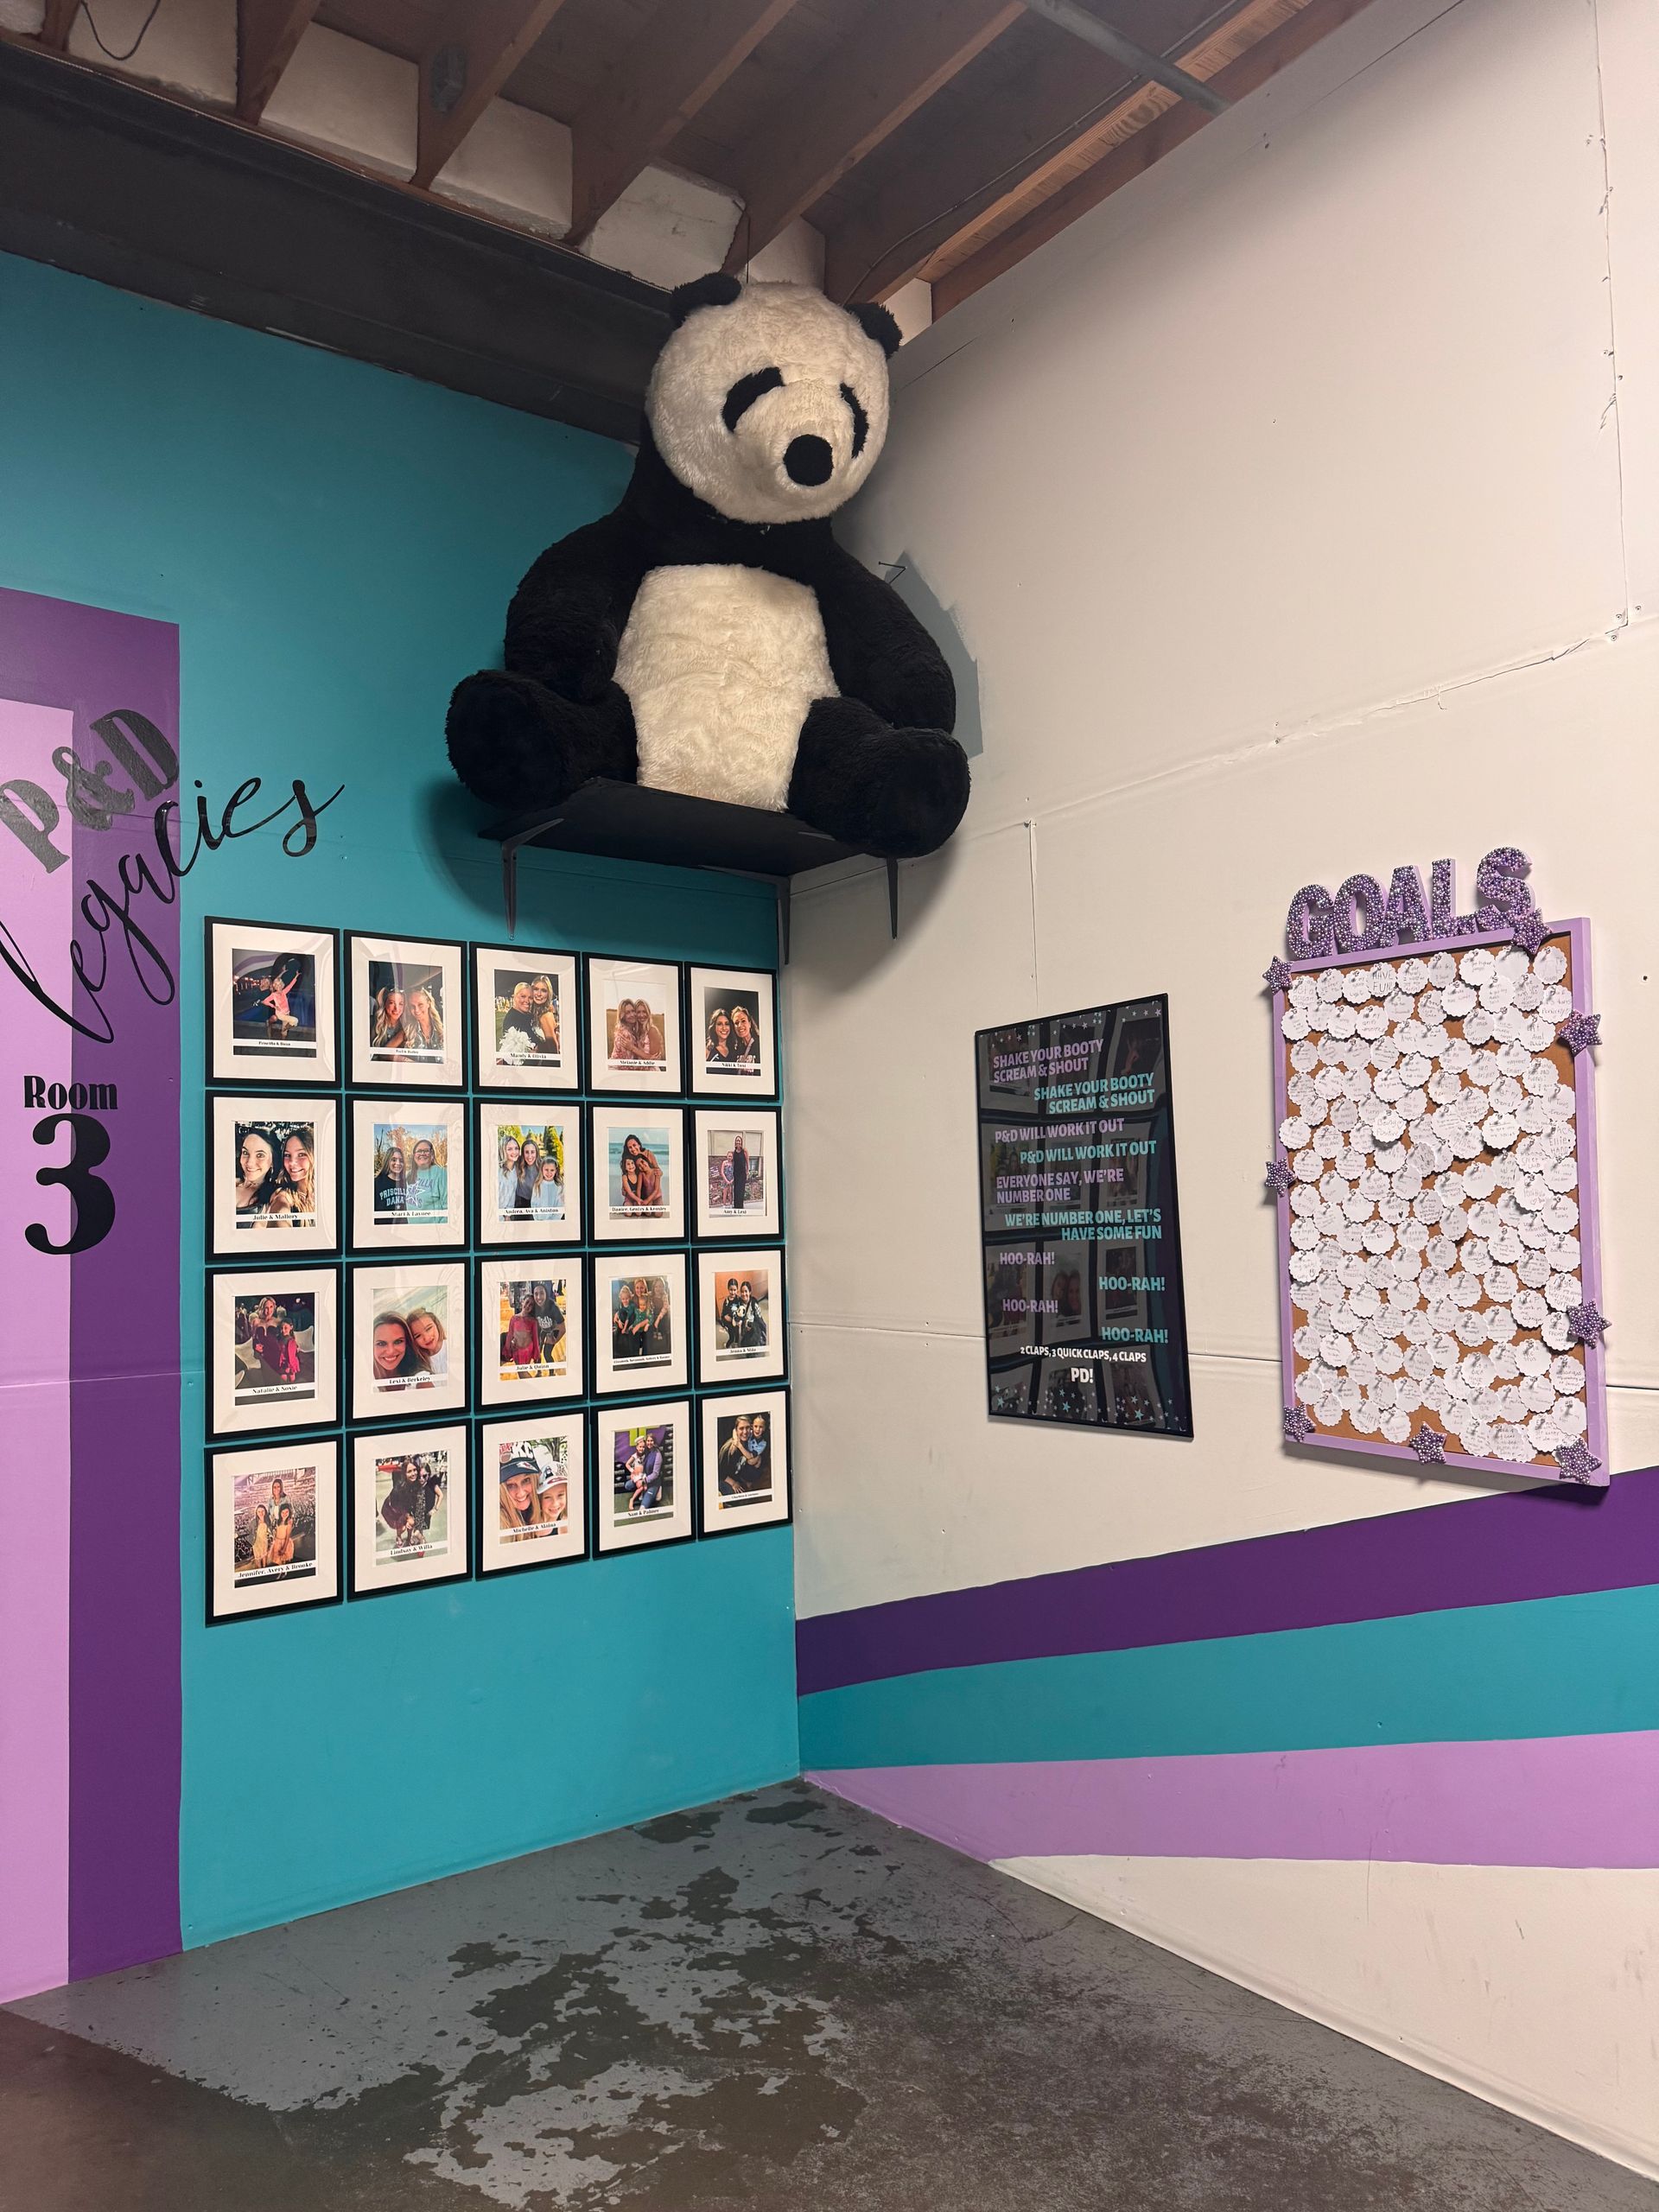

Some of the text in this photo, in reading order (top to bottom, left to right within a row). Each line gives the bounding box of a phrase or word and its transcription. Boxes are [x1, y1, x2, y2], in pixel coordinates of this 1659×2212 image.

[0, 709, 180, 874] P&D
[1286, 846, 1535, 960] GOALS
[994, 1039, 1103, 1069] SHAKE YOUR BOOTY
[995, 1058, 1089, 1083] SCREAM & SHOUT
[23, 1076, 118, 1111] Room
[1034, 1072, 1154, 1101] SHAKE YOUR BOOTY
[1049, 1090, 1154, 1114] SCREAM & SHOUT
[995, 1118, 1124, 1143] P&D WILL WORK IT OUT
[1020, 1141, 1156, 1164] P&D WILL WORK IT OUT
[24, 1112, 116, 1254] 3
[997, 1168, 1123, 1189] EVERYONE SAY, WE'RE
[997, 1188, 1071, 1204] NUMBER ONE
[1005, 1209, 1161, 1227] WE'RE NUMBER ONE, LET'S
[1062, 1225, 1161, 1241] HAVE SOME FUN
[1000, 1252, 1055, 1265] HOO-RAH!
[1098, 1276, 1165, 1291] HOO-RAH!
[1002, 1299, 1058, 1313] HOO-RAH!
[1102, 1326, 1168, 1344] HOO-RAH!
[1026, 1345, 1052, 1357] CLAPS,
[1052, 1349, 1057, 1357] 3
[1057, 1347, 1083, 1358] QUICK
[1084, 1349, 1112, 1361] CLAPS,
[1112, 1352, 1118, 1362] 4
[1119, 1351, 1147, 1363] CLAPS
[1071, 1367, 1094, 1382] PD!
